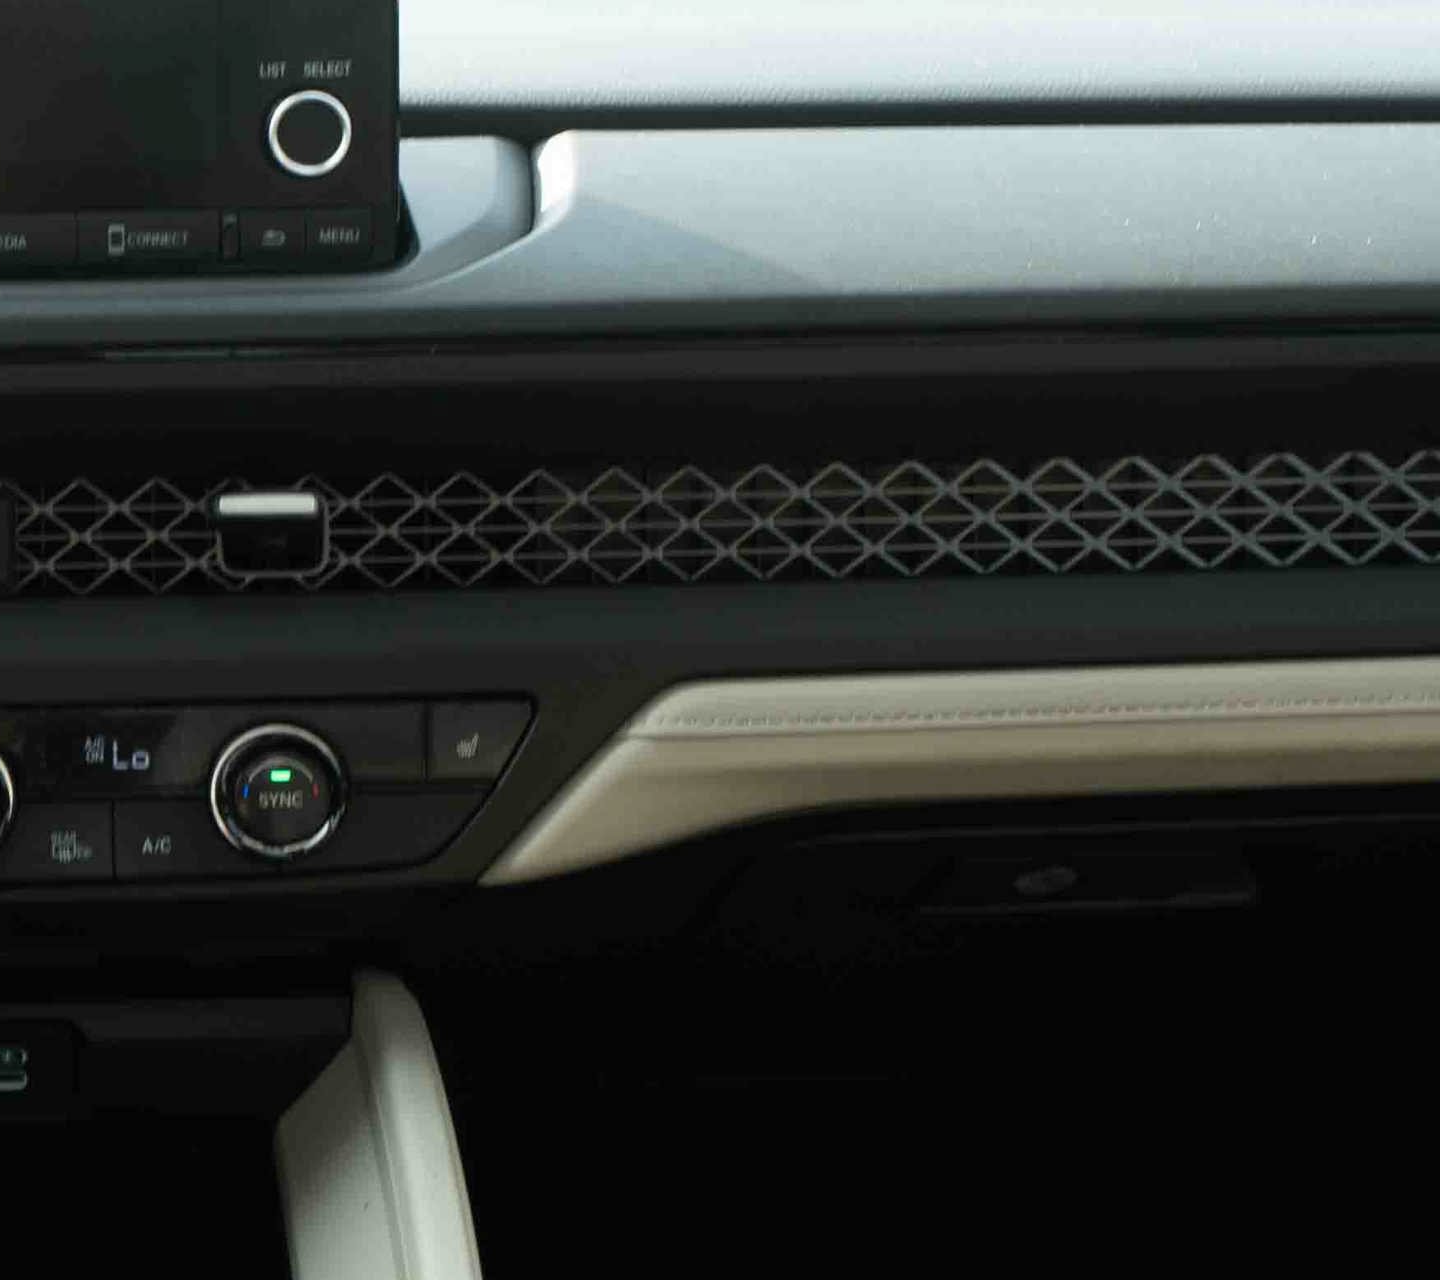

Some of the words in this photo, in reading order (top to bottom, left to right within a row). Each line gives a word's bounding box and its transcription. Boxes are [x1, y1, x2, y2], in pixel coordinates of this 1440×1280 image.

[260, 60, 287, 80] LIST
[304, 59, 351, 79] SELECT
[127, 230, 189, 250] CONNECT
[318, 225, 360, 245] MENU
[112, 738, 149, 771] Lo
[259, 791, 303, 809] SYNC
[142, 834, 172, 855] A/C
